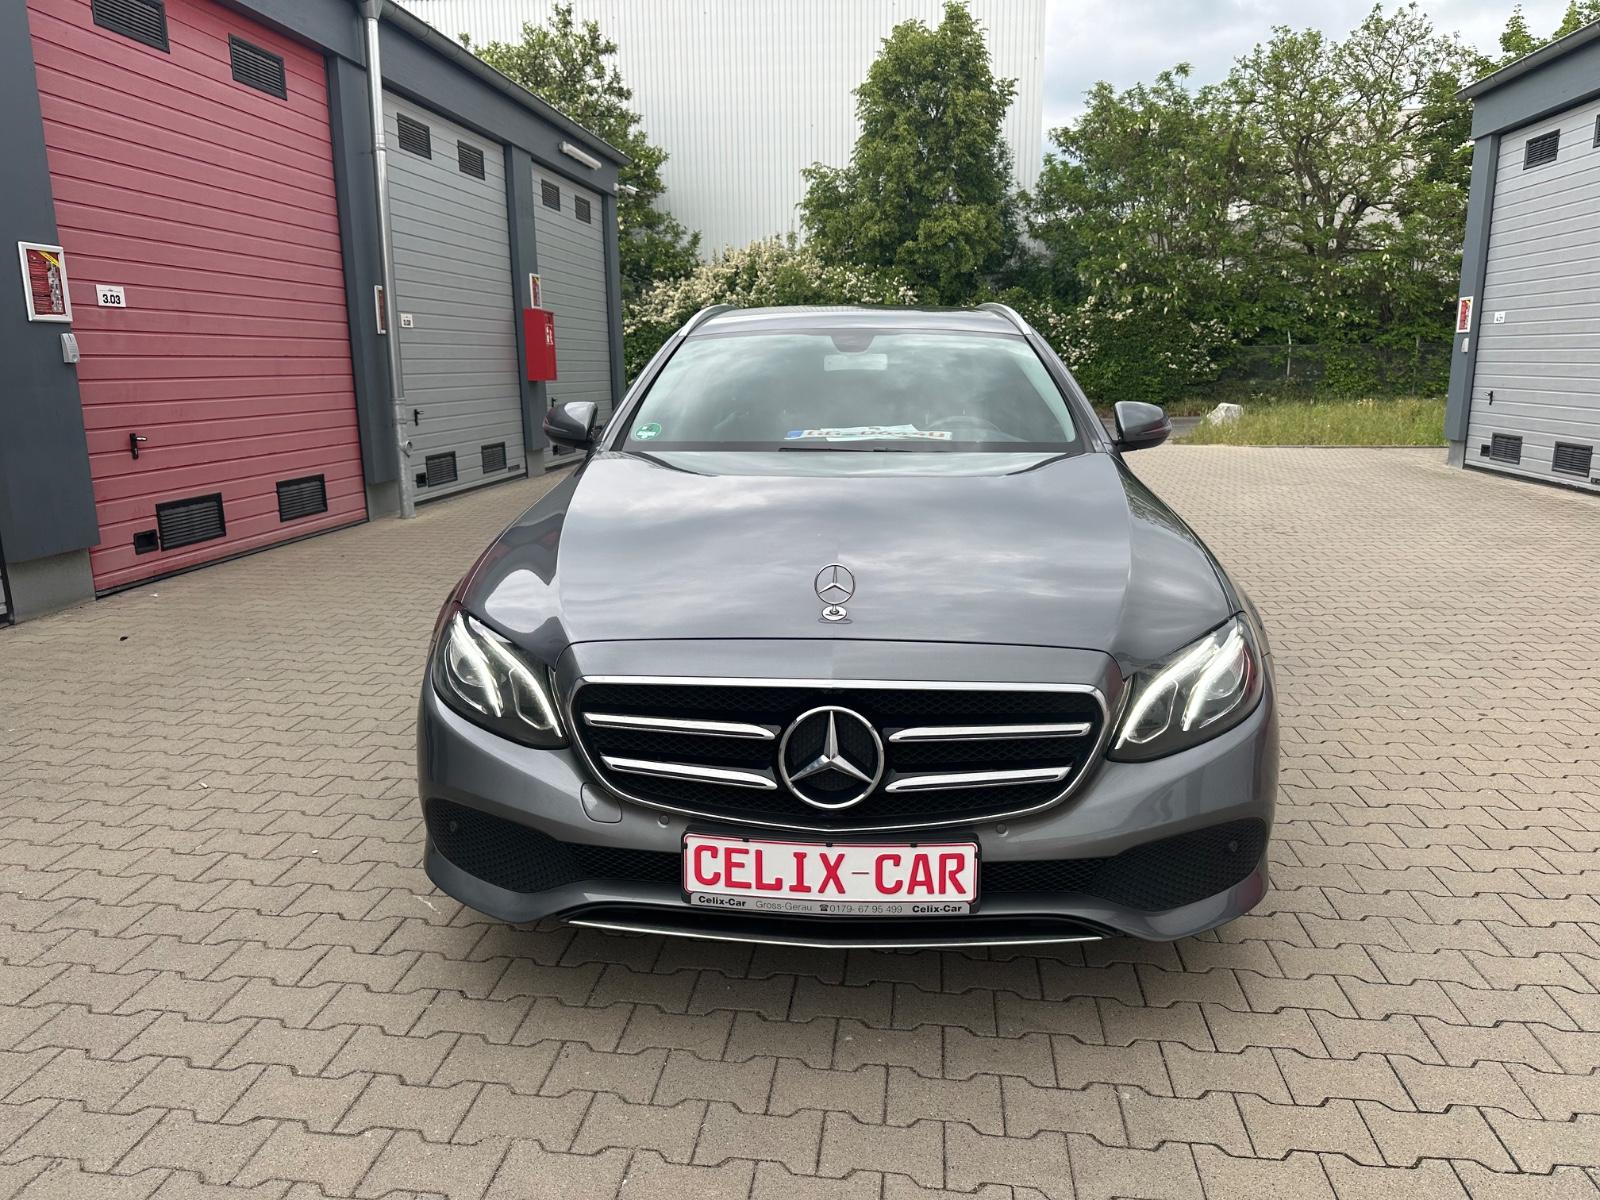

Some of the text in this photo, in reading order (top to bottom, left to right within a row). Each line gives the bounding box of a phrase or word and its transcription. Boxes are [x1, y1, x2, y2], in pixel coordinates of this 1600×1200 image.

[102, 294, 121, 304] 3.03
[694, 845, 966, 895] CELIX-CAR
[698, 896, 746, 907] Celix-Car
[755, 901, 812, 911] Gross-Gerau
[857, 903, 870, 913] 67
[871, 903, 884, 913] 95
[886, 903, 903, 913] 499
[912, 904, 962, 913] Celix-Car
